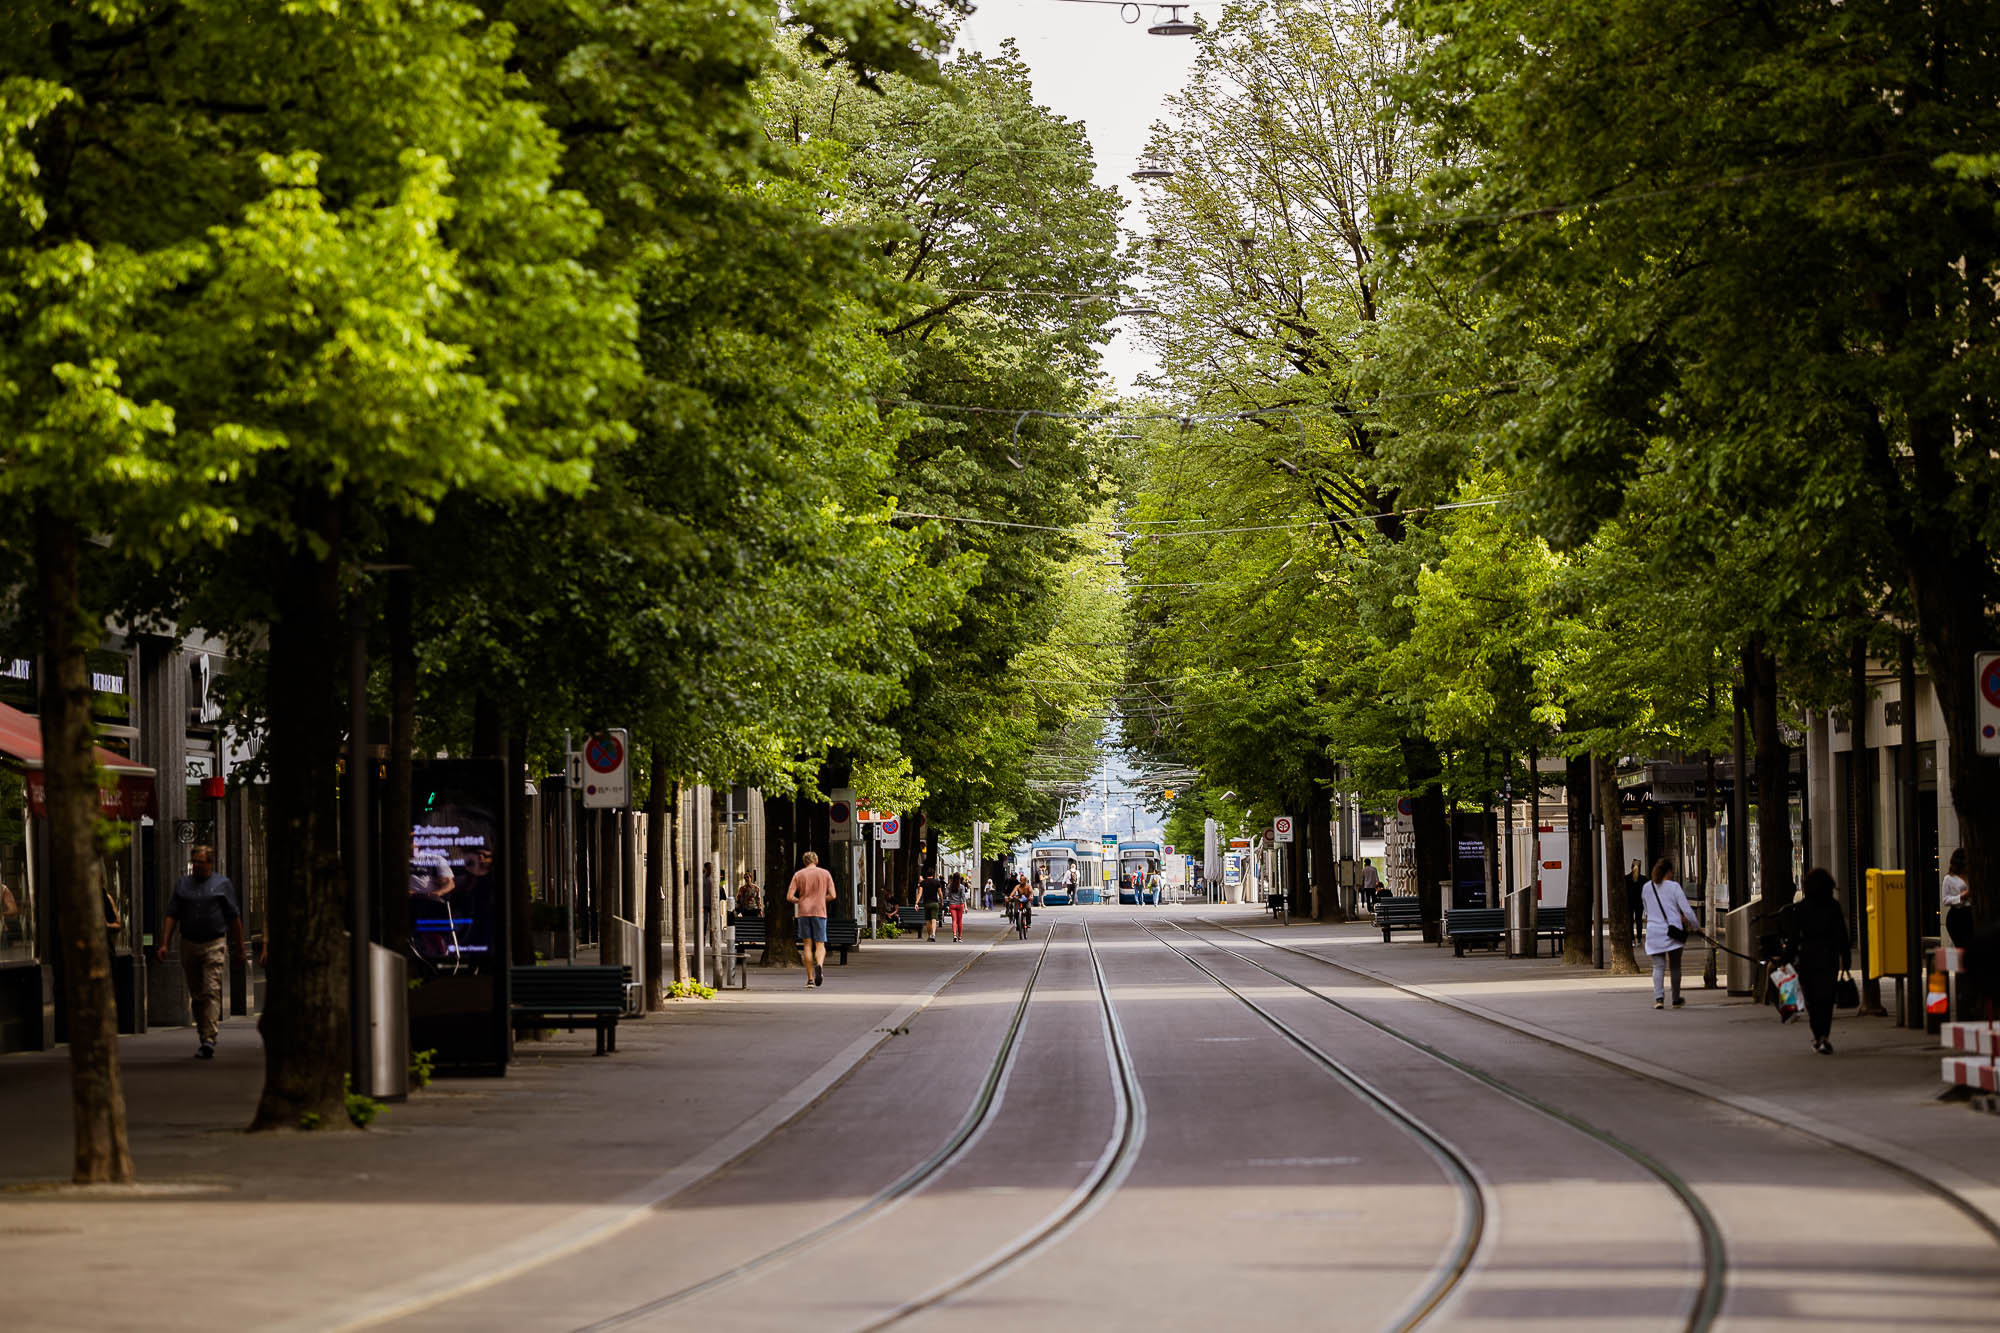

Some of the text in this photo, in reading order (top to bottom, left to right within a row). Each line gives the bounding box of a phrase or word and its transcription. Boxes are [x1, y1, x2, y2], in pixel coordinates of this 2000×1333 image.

[93, 672, 123, 695] BURBERRY
[413, 825, 460, 835] Zuhause
[413, 835, 485, 846] bleiben rettet
